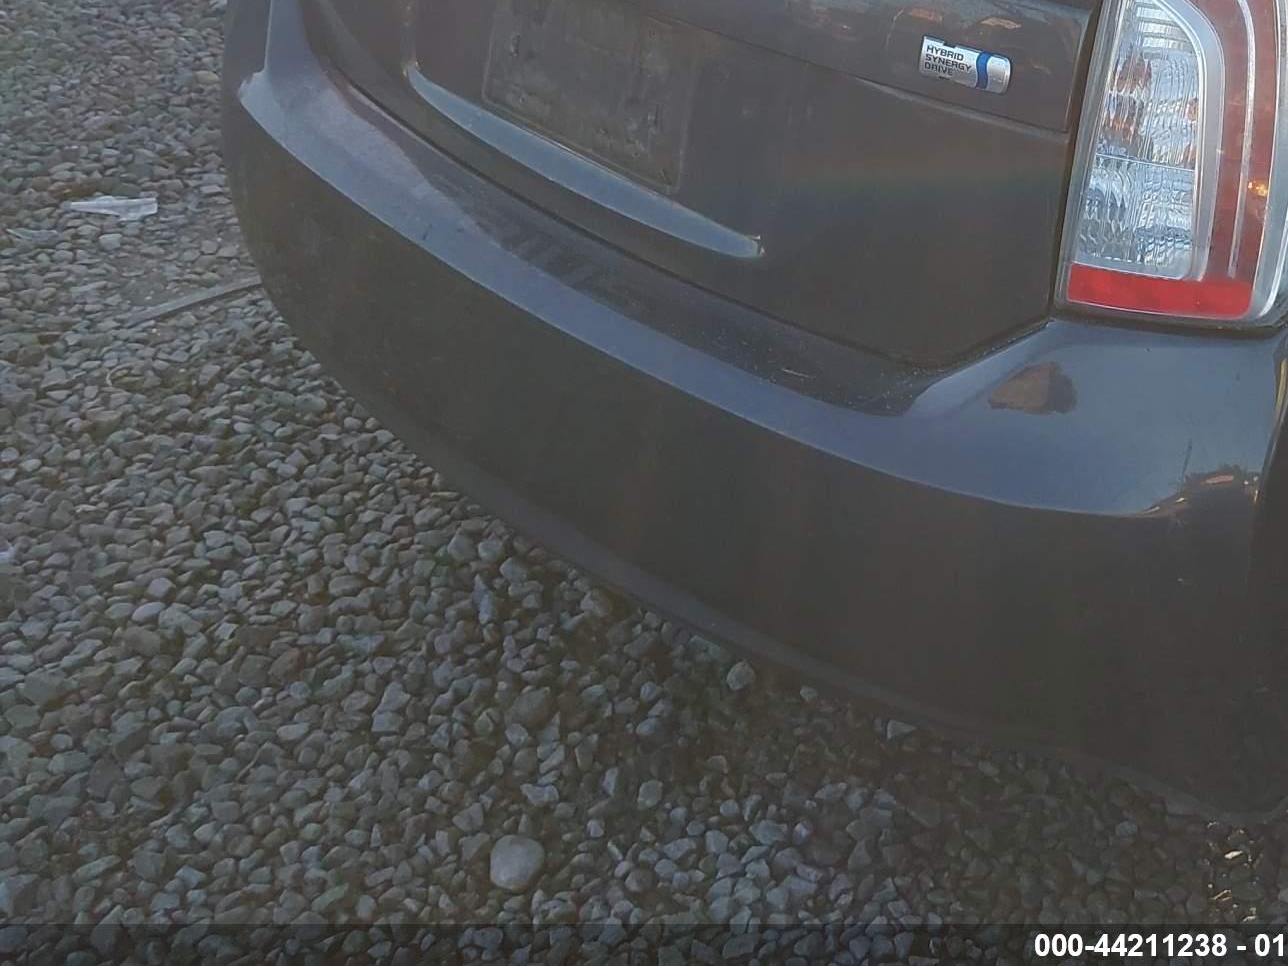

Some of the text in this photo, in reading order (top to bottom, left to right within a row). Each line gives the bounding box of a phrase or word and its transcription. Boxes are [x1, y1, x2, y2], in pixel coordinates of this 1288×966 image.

[926, 44, 964, 62] HYBRID
[923, 62, 954, 76] DRIVE
[924, 53, 972, 74] SYNERGY
